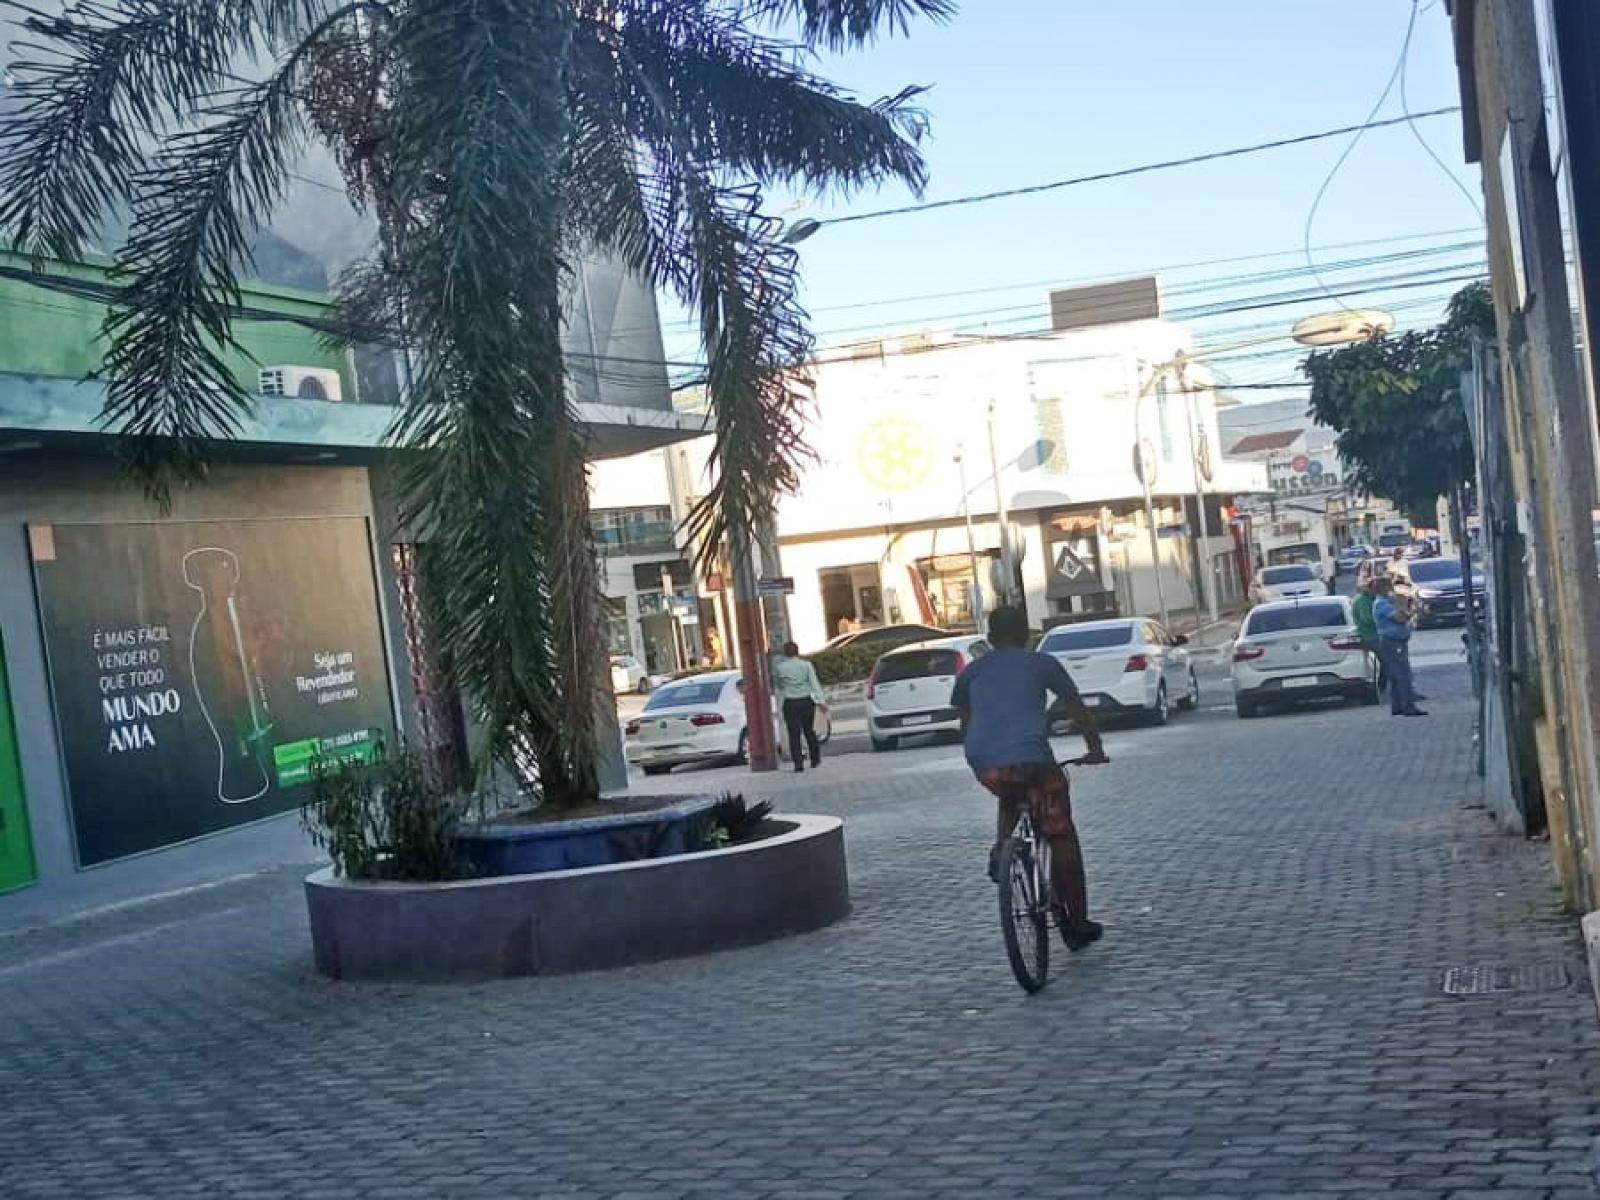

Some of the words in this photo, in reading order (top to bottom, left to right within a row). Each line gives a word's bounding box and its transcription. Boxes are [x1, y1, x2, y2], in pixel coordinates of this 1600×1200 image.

[104, 630, 136, 646] MAIS
[97, 649, 147, 669] VENDER
[149, 648, 160, 663] O
[99, 673, 125, 694] QUE
[129, 668, 164, 688] TODO
[102, 688, 180, 723] MUNDO
[107, 723, 156, 753] AMA
